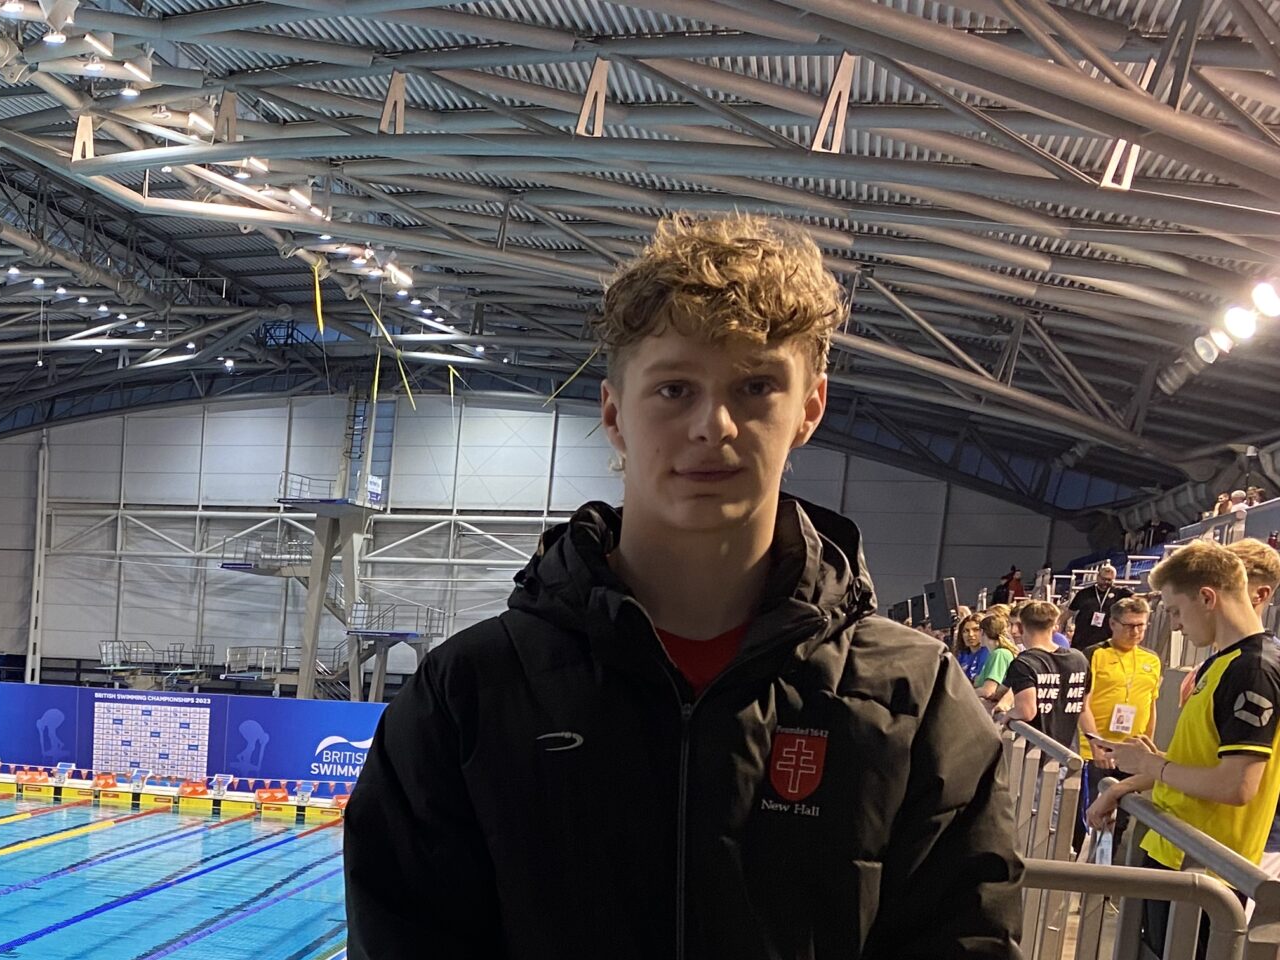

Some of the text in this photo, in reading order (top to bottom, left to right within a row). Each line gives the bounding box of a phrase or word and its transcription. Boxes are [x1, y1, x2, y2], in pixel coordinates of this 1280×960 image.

[1068, 671, 1086, 683] ME
[1066, 687, 1085, 698] ME
[147, 695, 195, 703] CHAMPIONSHIPS
[1064, 701, 1084, 713] ME
[310, 762, 363, 778] SWIMM
[761, 799, 820, 817] New Hall
